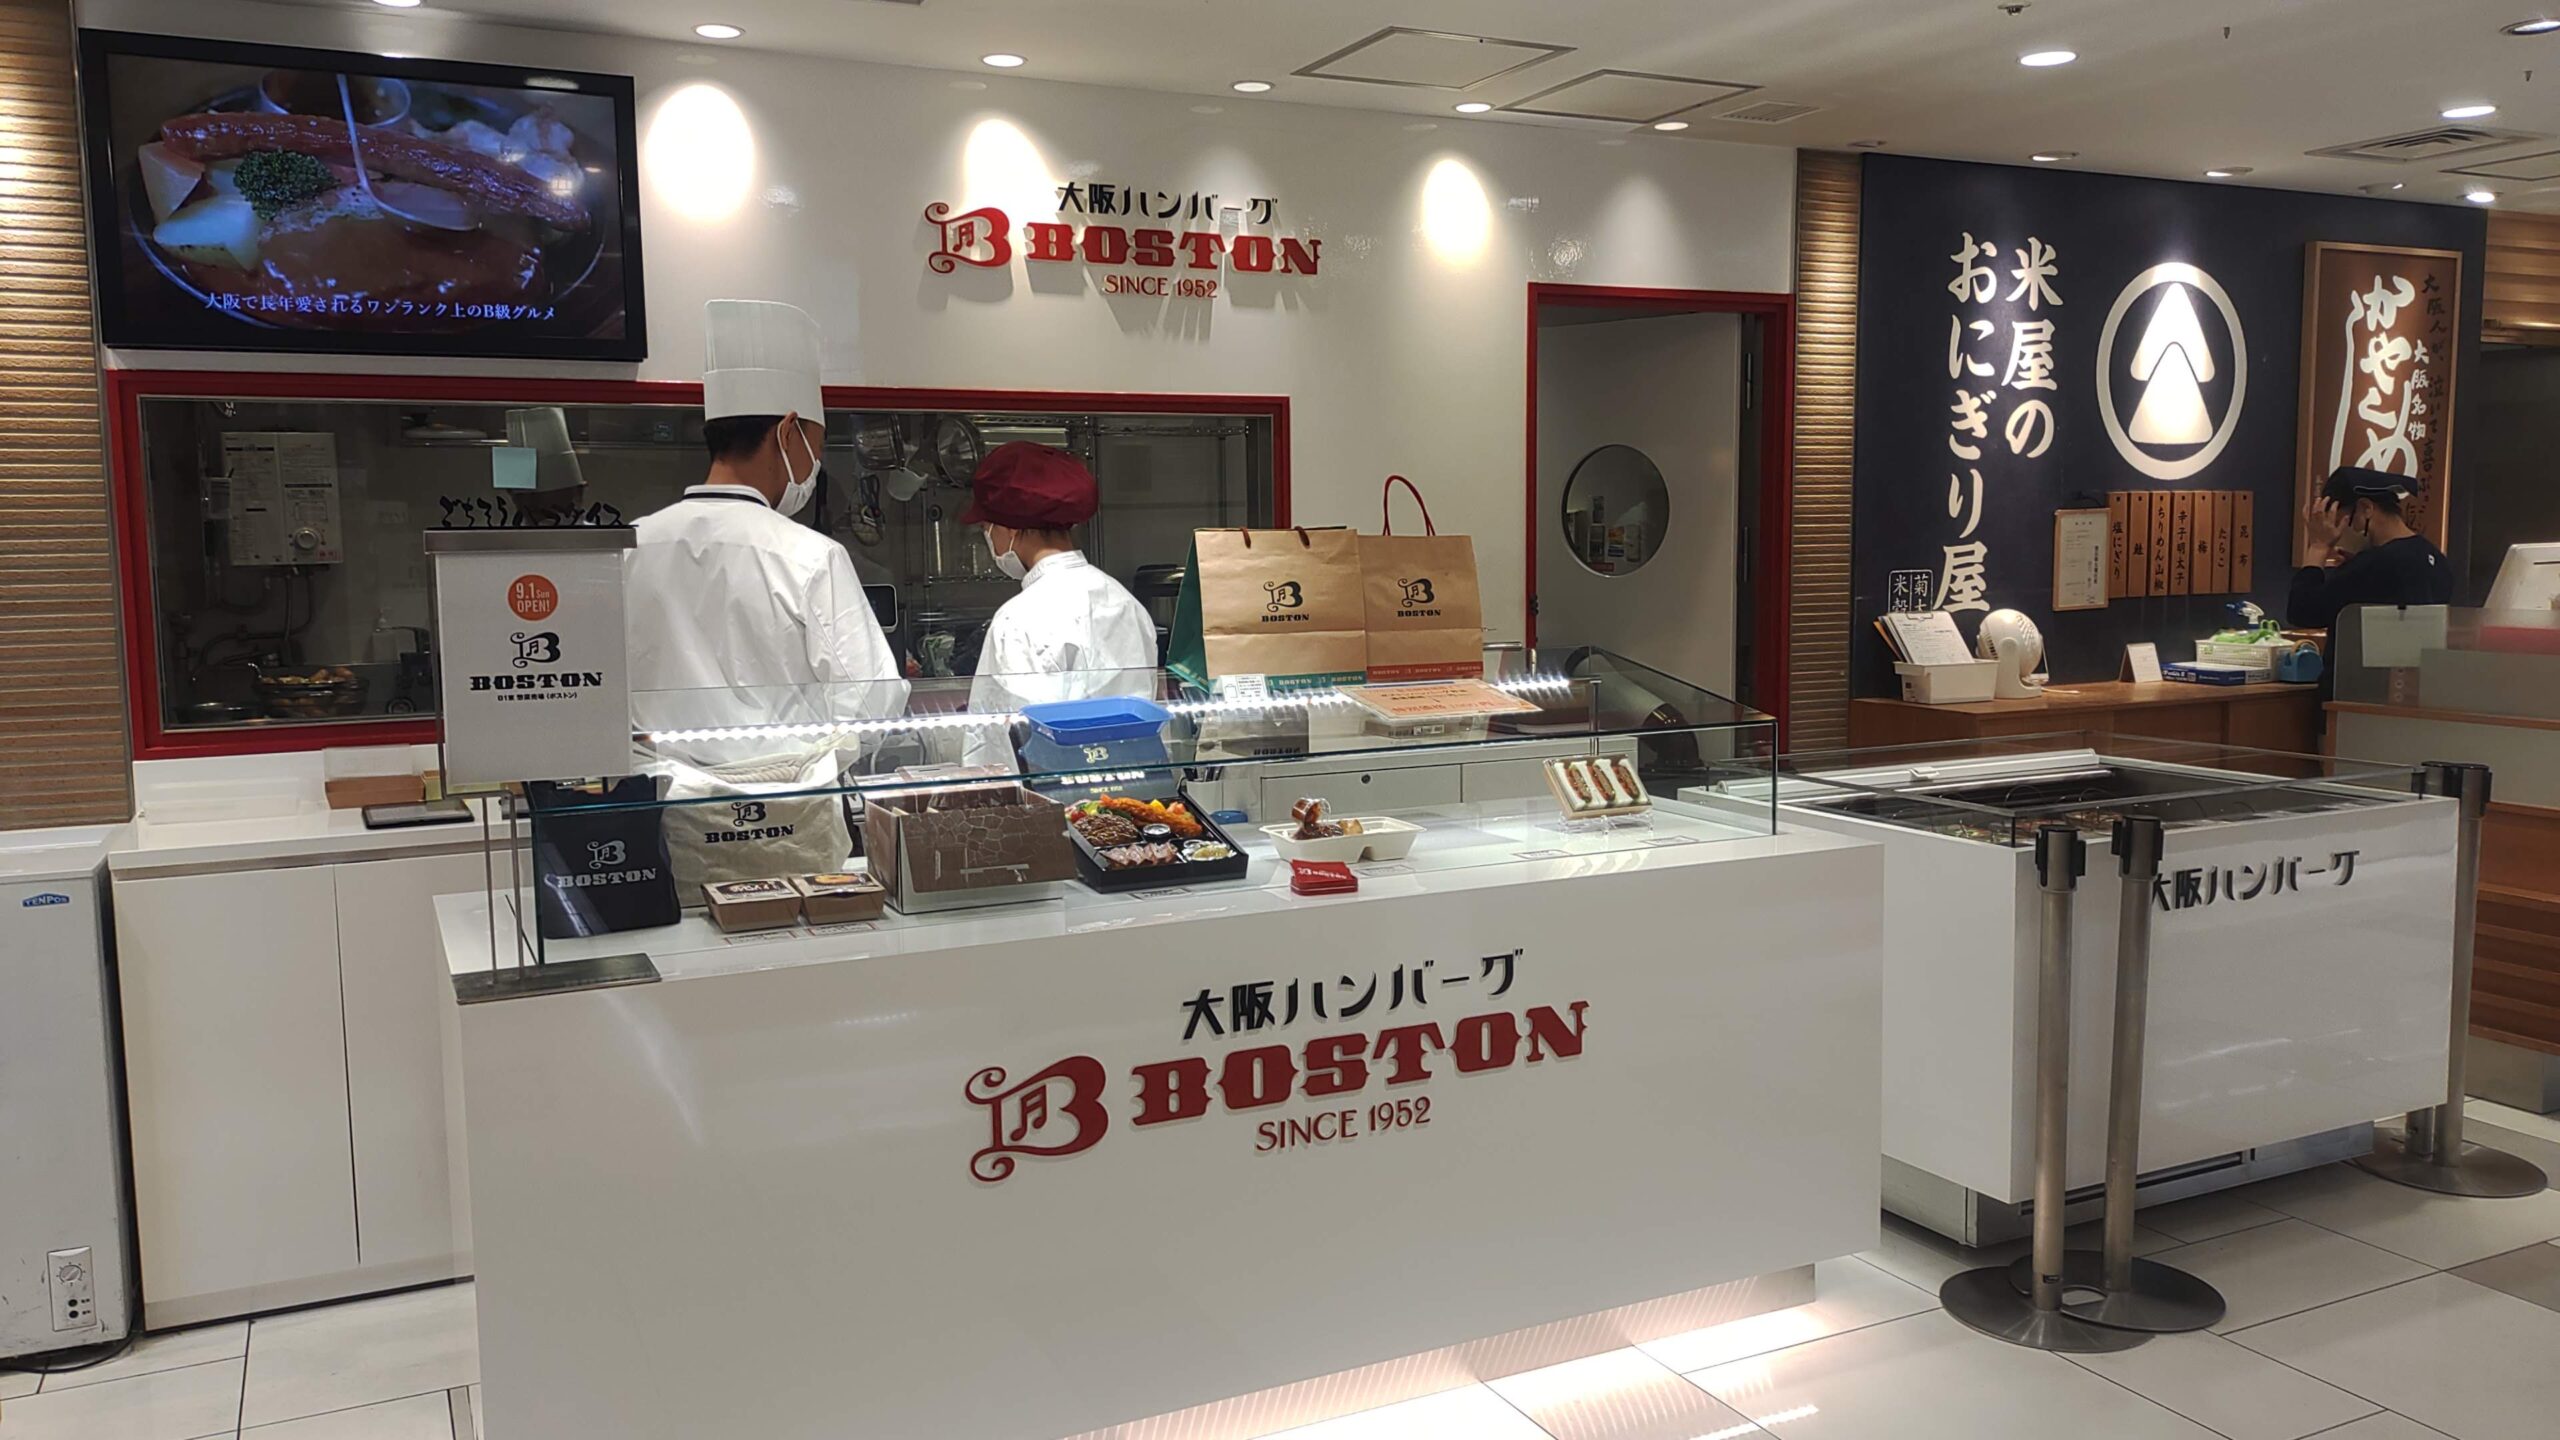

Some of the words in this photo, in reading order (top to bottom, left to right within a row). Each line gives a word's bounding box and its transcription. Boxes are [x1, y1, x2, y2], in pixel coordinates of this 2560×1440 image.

[1058, 181, 1278, 225] 大阪ハンバーグ
[1025, 221, 1323, 276] BOSTON
[1105, 275, 1169, 297] SINCE
[1176, 278, 1218, 298] 1952
[2001, 236, 2064, 459] 米屋の
[2407, 339, 2430, 441] 大阪名物
[1933, 231, 1998, 614] おにぎり屋
[2112, 521, 2124, 579] 塩にぎり
[2217, 527, 2226, 568] たらこ
[515, 582, 535, 600] 9.1
[536, 590, 550, 599] Sun
[517, 600, 551, 613] OPEN!
[1261, 613, 1310, 623] BOSTON
[1397, 609, 1442, 618] BOSTON
[469, 672, 603, 691] BOSTON
[704, 824, 795, 844] BOSTON
[557, 867, 658, 888] BOSTON
[1183, 948, 1524, 1040] 大阪ハンバーグ
[1130, 1000, 1590, 1126] BOSTON
[1256, 1109, 1358, 1151] SINCE
[1368, 1096, 1432, 1131] 1952
